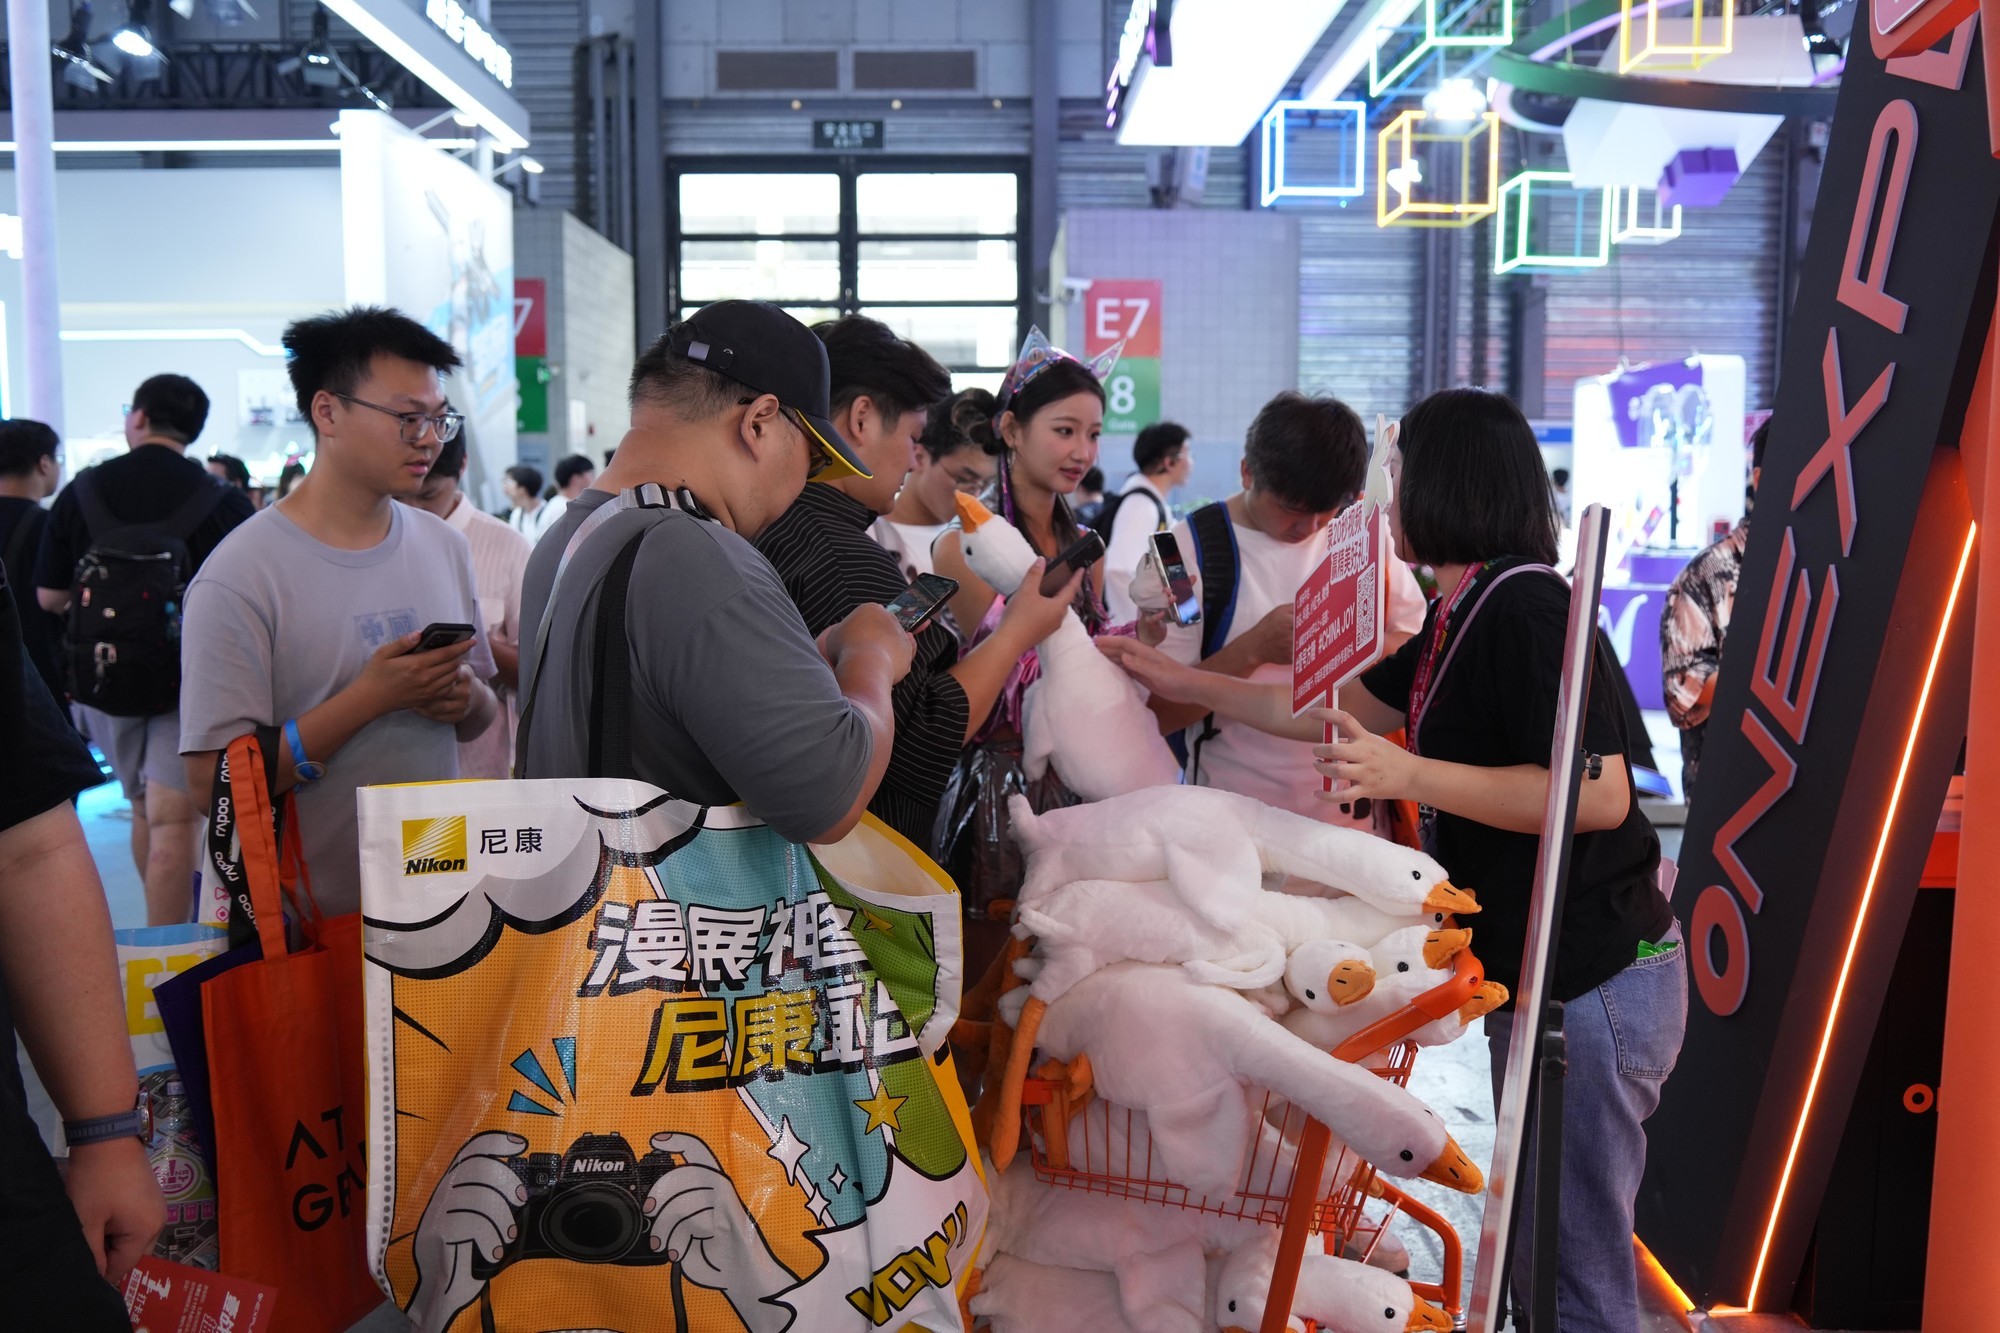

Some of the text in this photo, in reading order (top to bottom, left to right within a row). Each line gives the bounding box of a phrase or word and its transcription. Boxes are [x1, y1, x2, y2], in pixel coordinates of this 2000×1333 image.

[1096, 298, 1150, 339] E7
[1110, 375, 1136, 414] 8
[1341, 602, 1356, 633] JOY
[479, 826, 543, 855] 尼康
[405, 857, 466, 875] Nikon
[572, 1158, 625, 1173] Nikon
